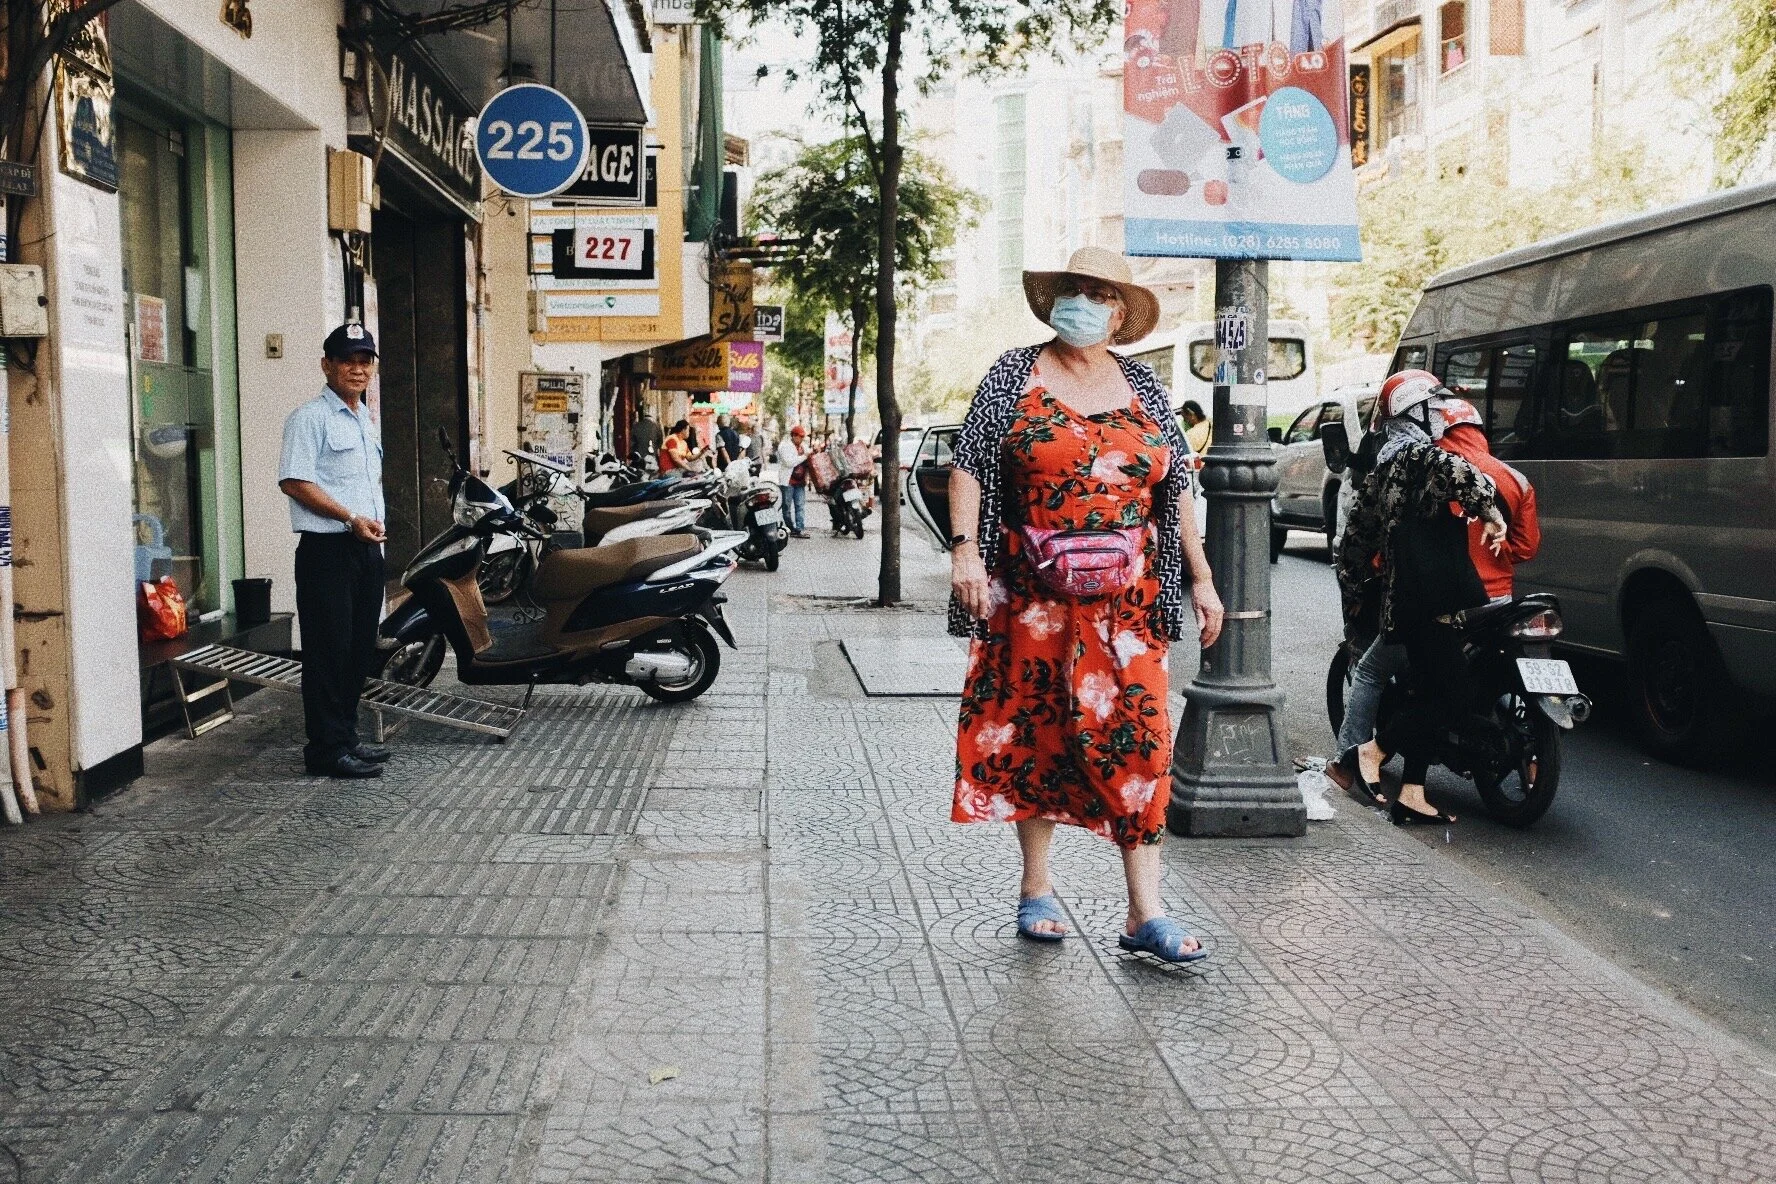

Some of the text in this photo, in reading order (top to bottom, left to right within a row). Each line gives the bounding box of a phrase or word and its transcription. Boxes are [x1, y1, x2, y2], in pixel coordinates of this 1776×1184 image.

[487, 120, 574, 162] 225
[585, 236, 632, 261] 227
[1156, 232, 1217, 247] Hotline:
[1222, 234, 1261, 249] (028)
[1266, 236, 1299, 248] 6285
[659, 582, 695, 594] LEAD
